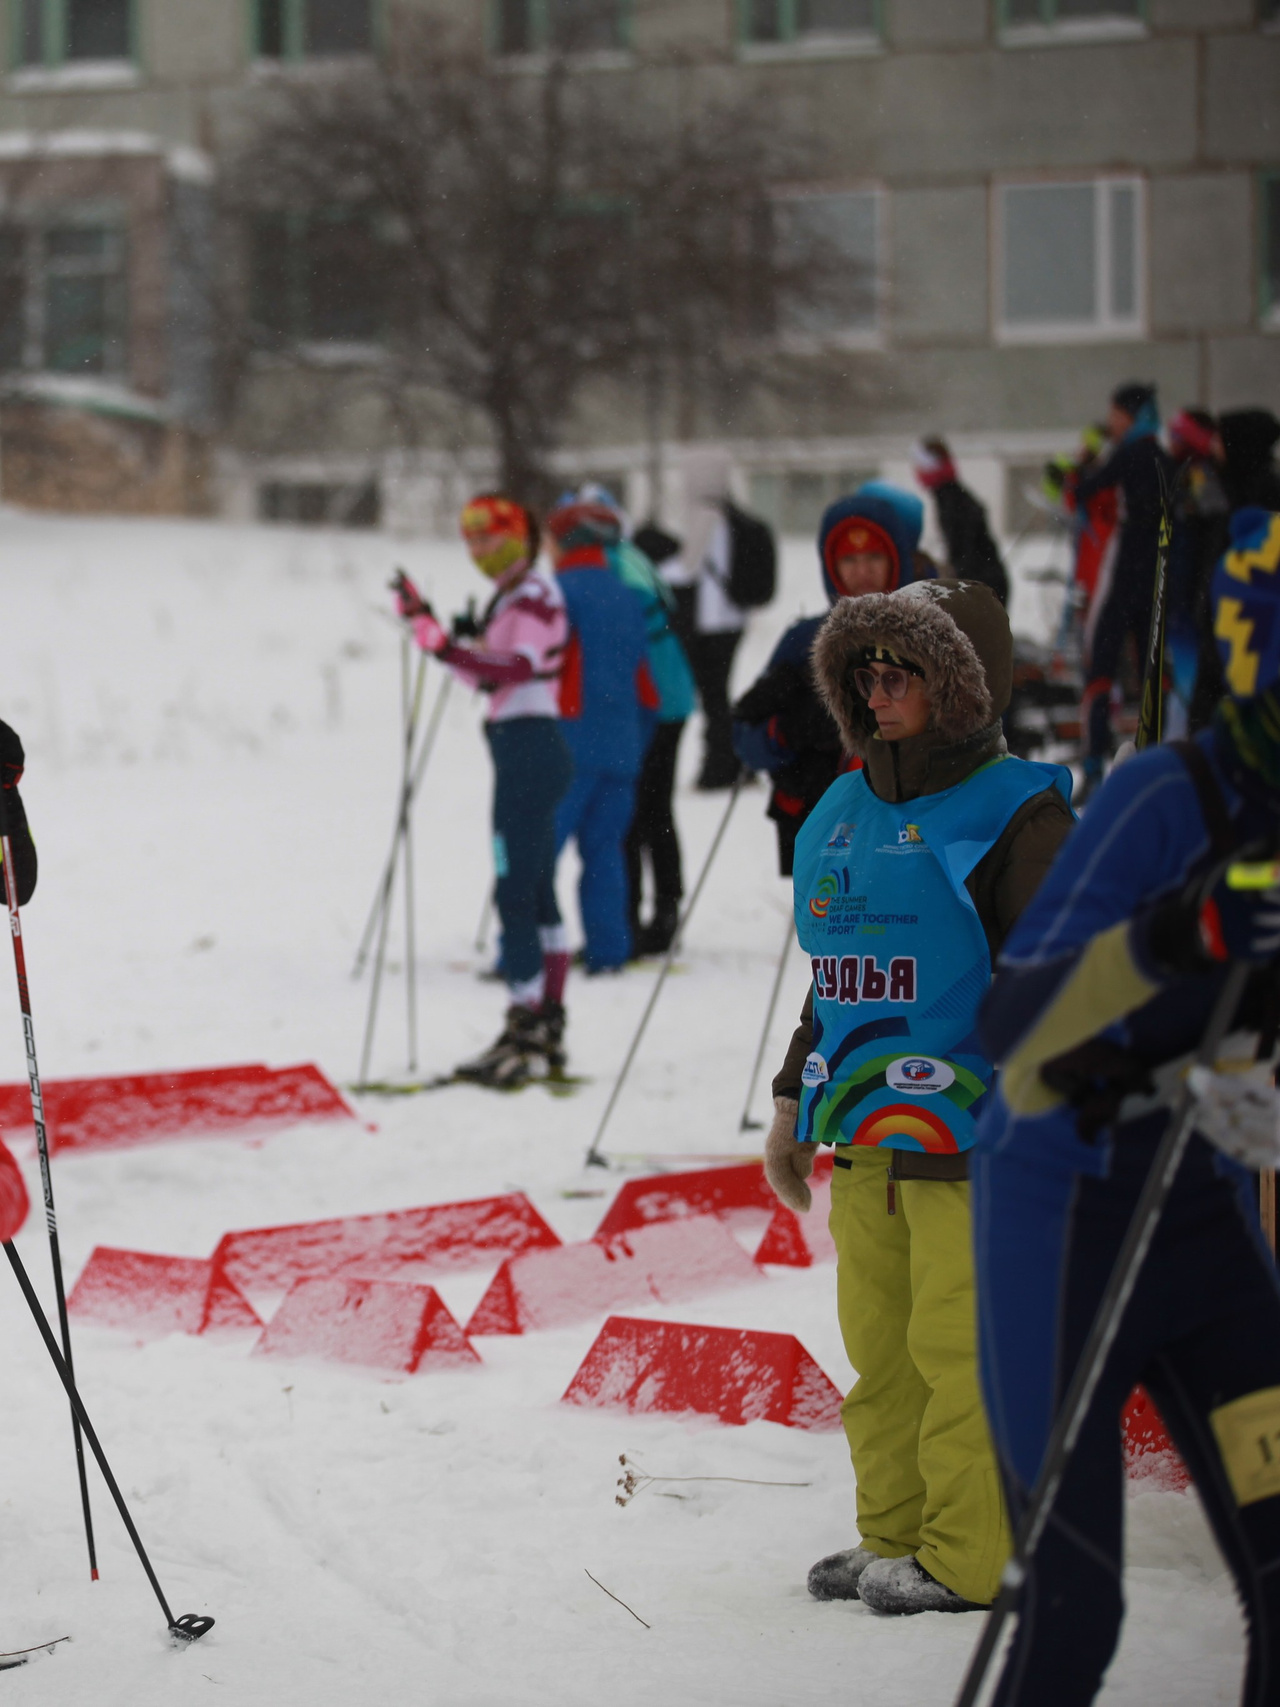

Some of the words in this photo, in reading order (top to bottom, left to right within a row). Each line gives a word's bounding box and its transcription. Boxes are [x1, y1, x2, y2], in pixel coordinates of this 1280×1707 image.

[841, 895, 867, 904] SUMMER
[829, 905, 843, 913] DEAF
[844, 904, 866, 912] GAMES
[829, 914, 842, 924] WE
[843, 914, 860, 924] ARE
[862, 914, 919, 925] TOGETHER
[827, 925, 855, 935] SPORT
[811, 955, 917, 1005] СУДЬЯ
